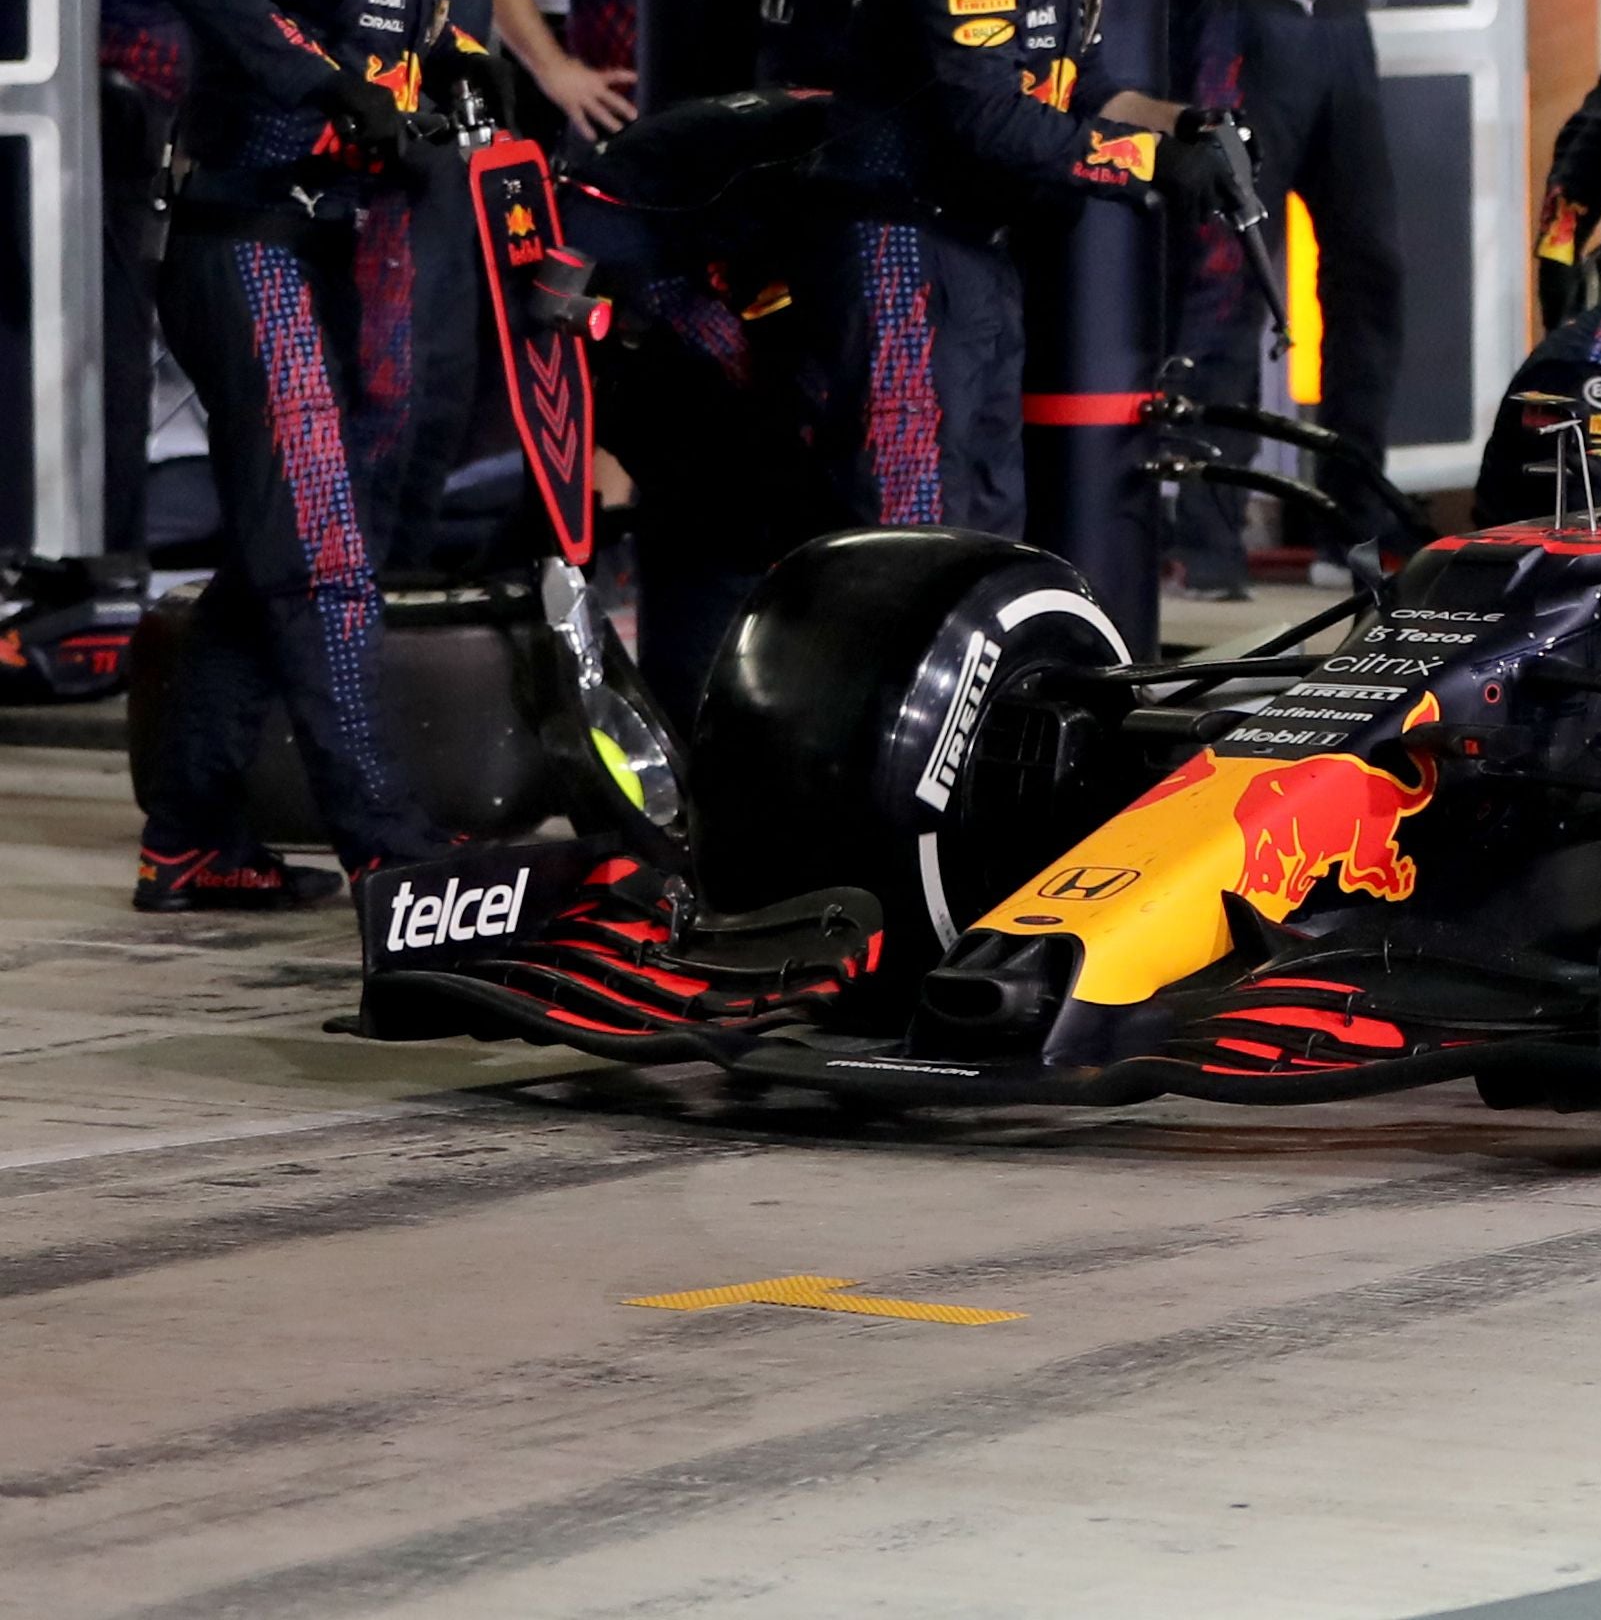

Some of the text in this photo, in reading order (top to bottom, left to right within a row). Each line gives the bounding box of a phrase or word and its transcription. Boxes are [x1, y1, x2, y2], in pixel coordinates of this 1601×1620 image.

[1390, 609, 1505, 624] ORACLE
[1395, 628, 1478, 645] Tezos
[1323, 652, 1444, 677] citrix
[1285, 683, 1409, 702] PIRELLI
[915, 630, 1003, 813] PIRELLI
[1257, 706, 1374, 723] infinitum
[1224, 727, 1311, 745] Mobil
[386, 867, 531, 953] telcel
